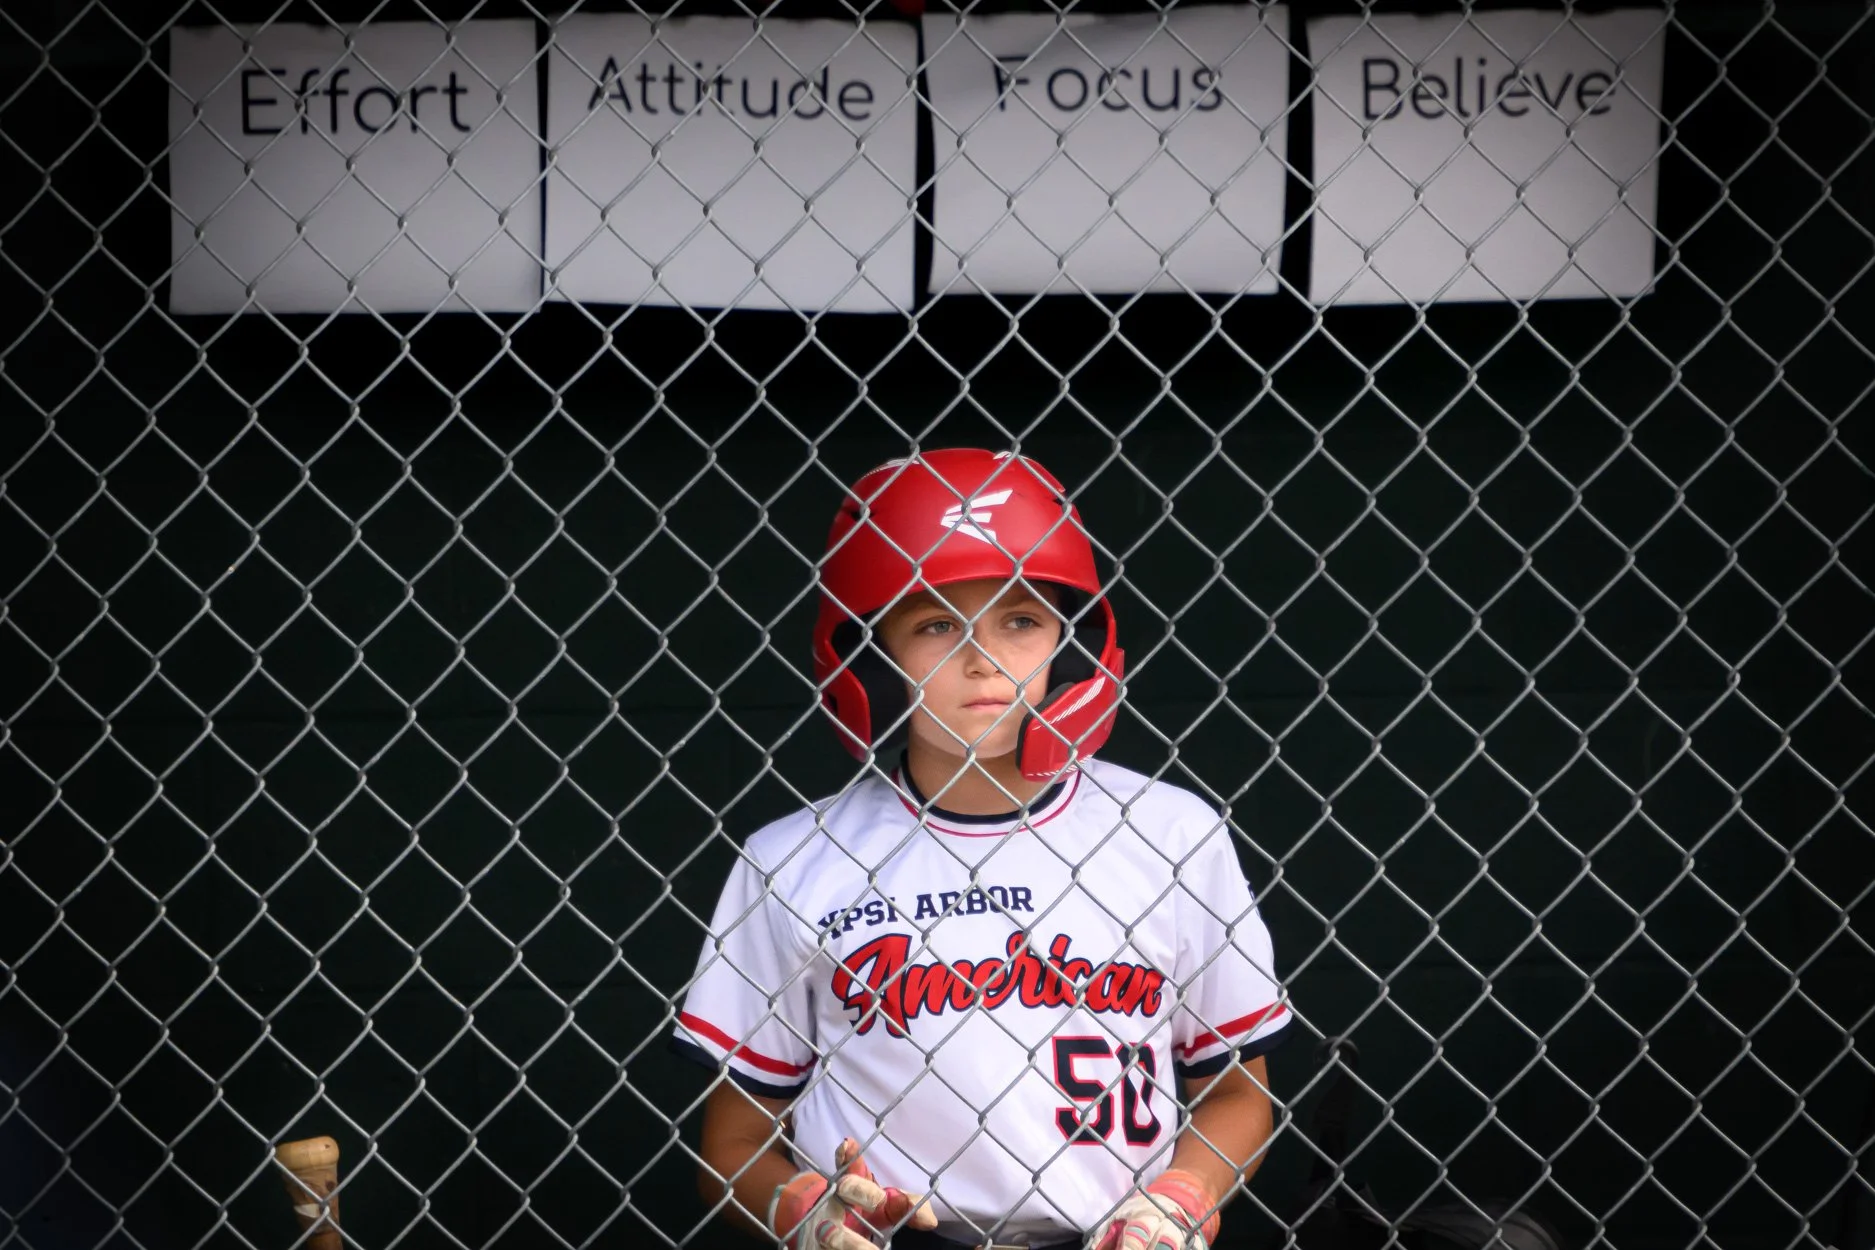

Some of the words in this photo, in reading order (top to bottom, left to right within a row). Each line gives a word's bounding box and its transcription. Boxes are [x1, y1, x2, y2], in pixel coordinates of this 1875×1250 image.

[240, 68, 471, 135] Effort
[588, 56, 874, 121] Attitude
[992, 54, 1224, 113] Focus
[1362, 56, 1616, 119] Believe
[818, 897, 898, 939] YPSI
[914, 886, 1034, 920] ARBOR
[831, 931, 1165, 1037] American
[1052, 1036, 1161, 1146] 50
